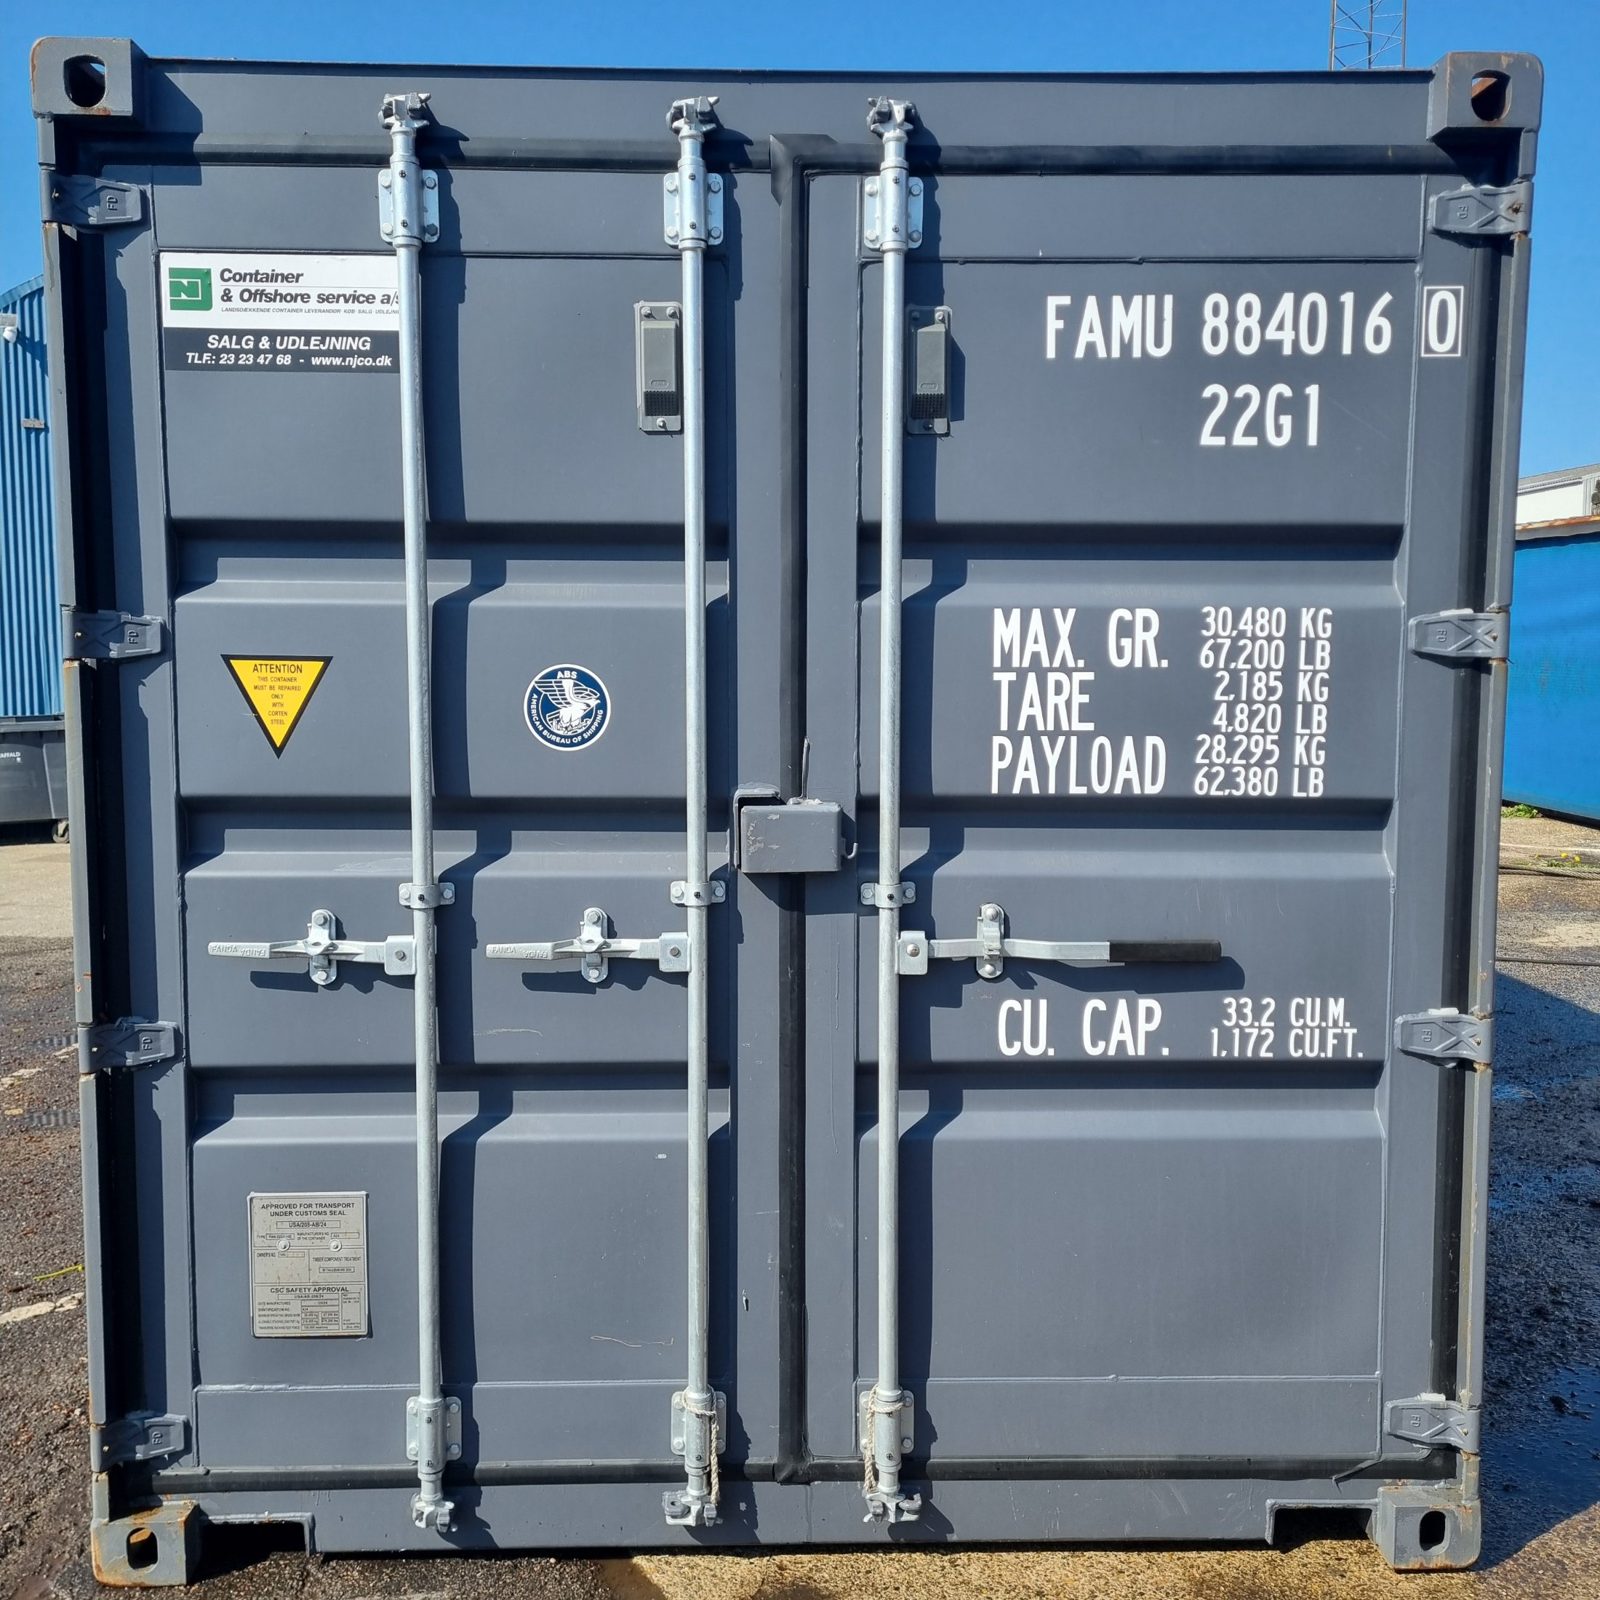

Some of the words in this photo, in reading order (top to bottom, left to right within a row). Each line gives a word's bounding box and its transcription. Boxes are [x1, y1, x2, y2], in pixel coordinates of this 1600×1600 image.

[219, 267, 304, 284] Container
[220, 288, 234, 305] &
[239, 288, 311, 305] Offshore
[316, 290, 376, 305] service
[1046, 295, 1173, 359] FAMU
[1202, 291, 1393, 356] 884016
[1428, 290, 1457, 352] 0
[207, 334, 255, 350] SALG
[259, 335, 271, 350] &
[275, 335, 371, 351] UDLEJNING
[219, 353, 236, 365] 23
[237, 353, 255, 365] 23
[256, 354, 273, 365] 47
[276, 354, 292, 365] 68
[311, 355, 392, 367] www.njco.dk
[1200, 383, 1320, 446] 22G1
[993, 607, 1085, 668] MAX.
[1108, 607, 1169, 668] GR.
[1201, 606, 1287, 637] 30,480
[1300, 607, 1333, 638] KG
[252, 663, 303, 674] ATTENTION
[1200, 639, 1286, 669] 67,200
[1299, 640, 1331, 670] LB
[556, 670, 578, 680] ABS
[1214, 671, 1283, 702] 2,185
[1297, 672, 1329, 702] KG
[993, 672, 1095, 731] TARE
[530, 693, 545, 732] AMERICAN
[542, 729, 571, 744] BUREAU
[572, 735, 582, 744] OF
[582, 709, 604, 739] SHIPPING
[1213, 703, 1282, 733] 4,820
[1296, 704, 1328, 734] LB
[991, 735, 1167, 794] PAYLOAD
[1195, 734, 1280, 765] 28,295
[1294, 736, 1326, 766] KG
[1194, 766, 1279, 796] 62,380
[1293, 767, 1324, 797] LB
[999, 998, 1055, 1056] CU.
[1082, 998, 1170, 1056] CAP.
[1222, 997, 1275, 1027] 33.2
[1290, 997, 1351, 1027] CU.M.
[1211, 1028, 1274, 1058] 1,172
[1289, 1028, 1364, 1058] CU.FT.
